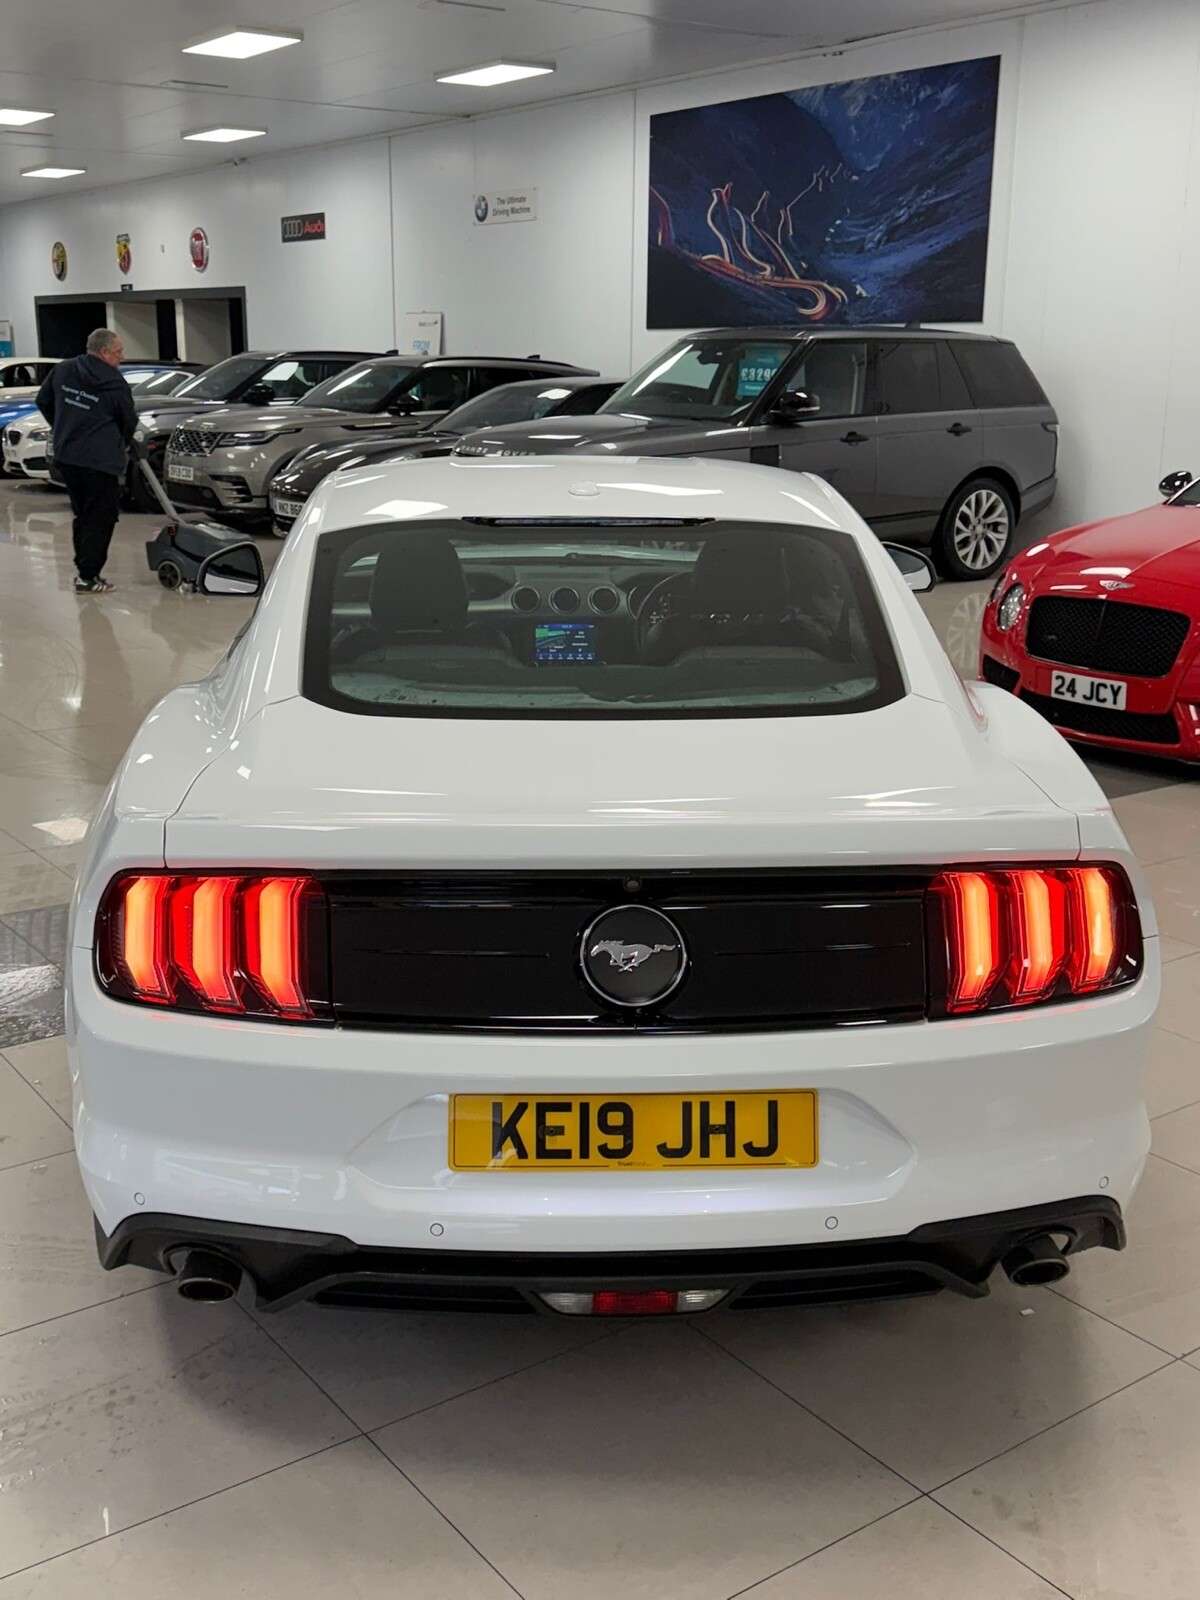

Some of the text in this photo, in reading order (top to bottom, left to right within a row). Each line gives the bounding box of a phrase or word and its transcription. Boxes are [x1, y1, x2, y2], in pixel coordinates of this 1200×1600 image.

[496, 196, 527, 205] The Ultimate
[492, 208, 510, 216] Driving
[303, 220, 325, 234] Audi
[1054, 675, 1122, 706] 24 JCY
[492, 1100, 779, 1160] KE19 JHJ
